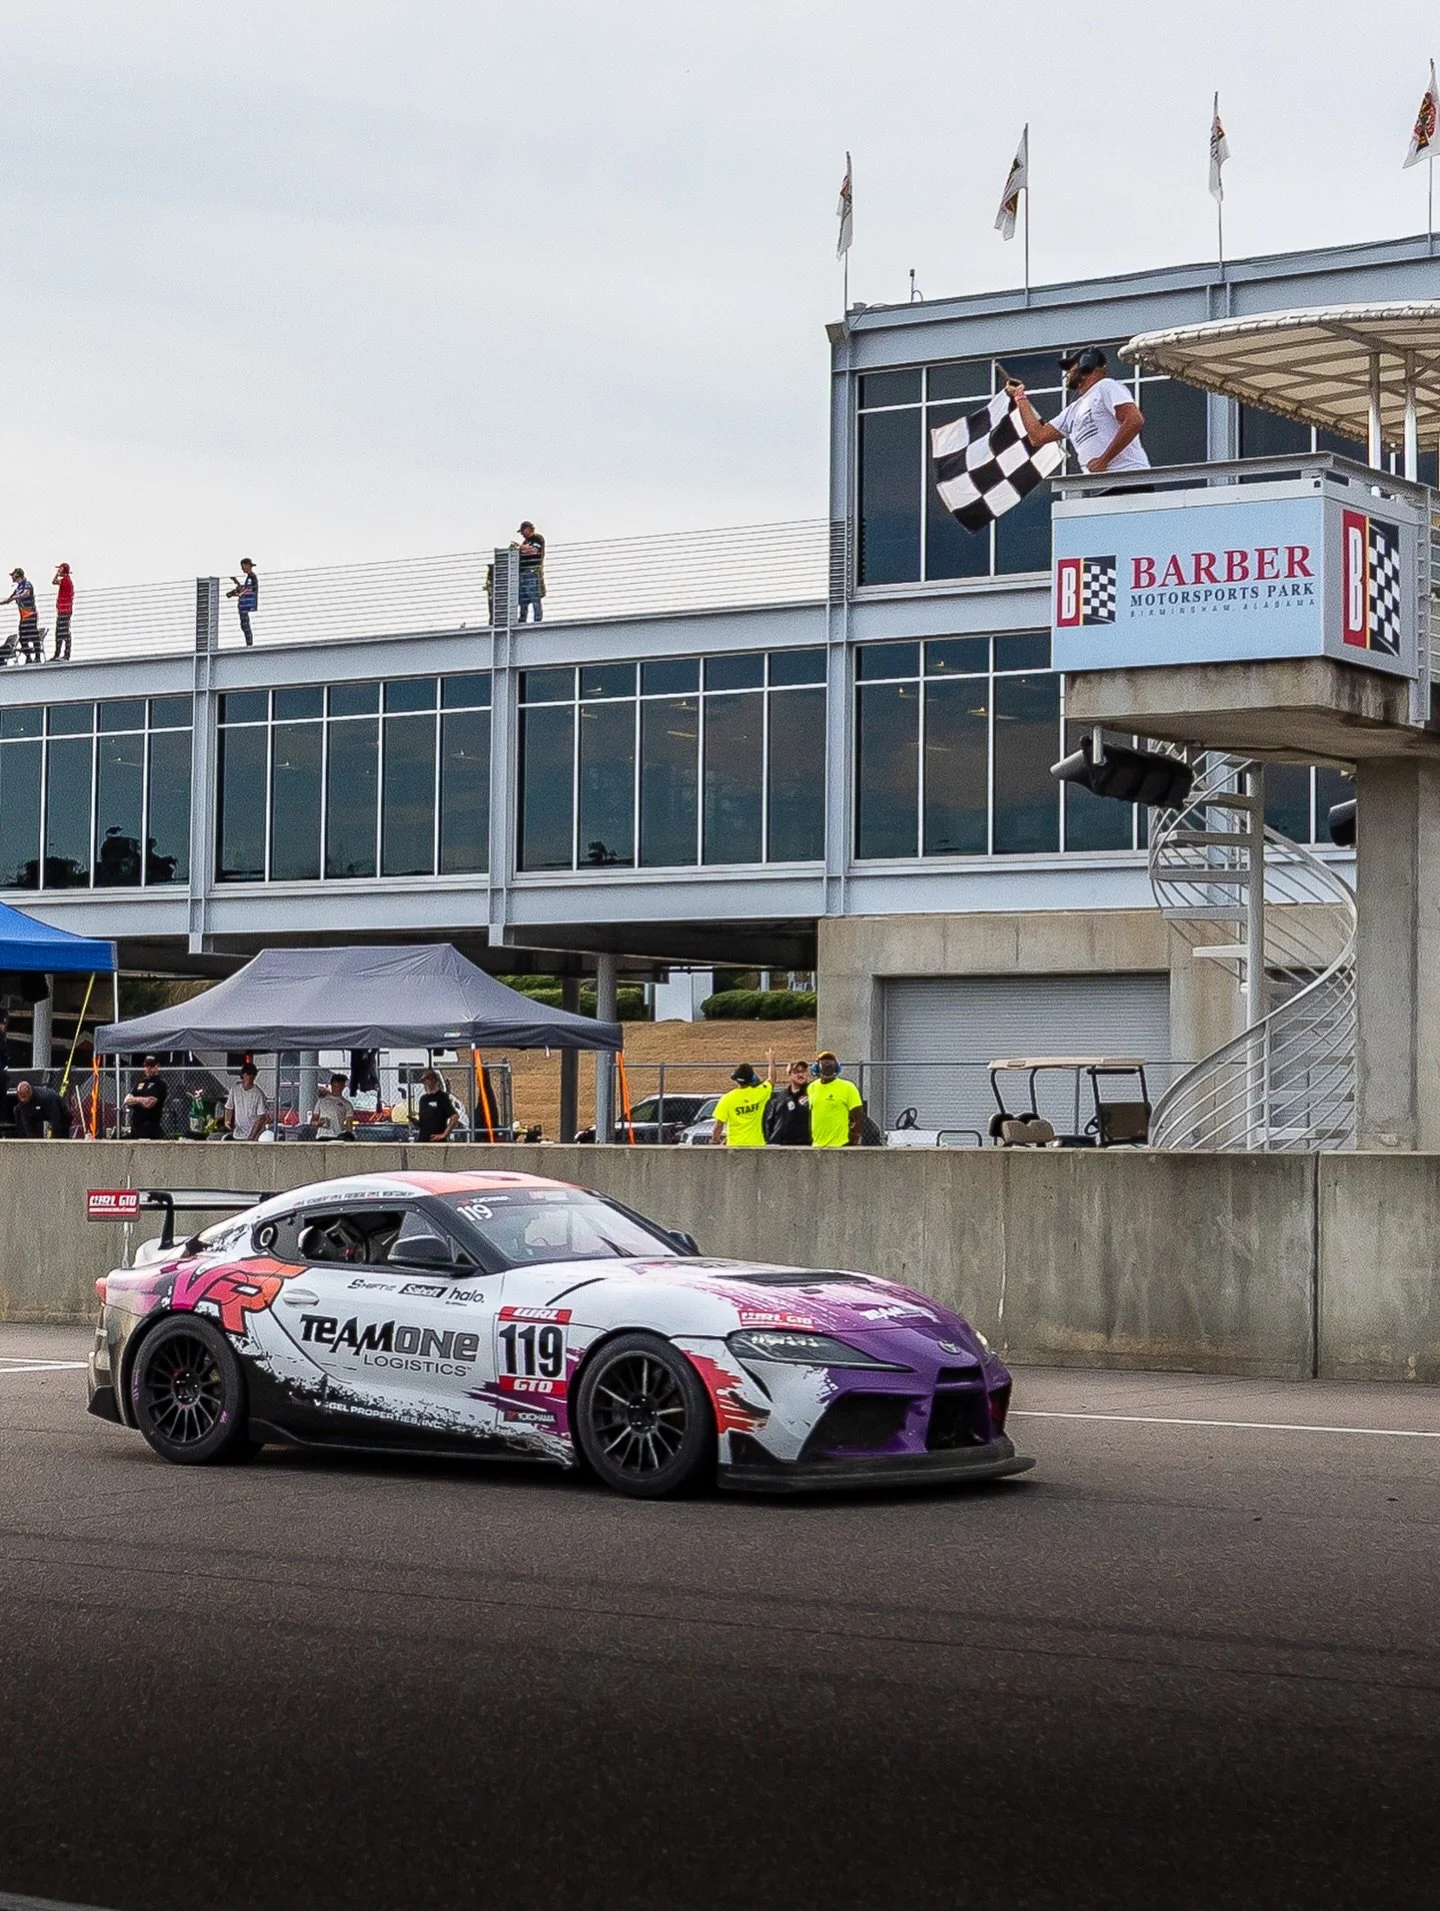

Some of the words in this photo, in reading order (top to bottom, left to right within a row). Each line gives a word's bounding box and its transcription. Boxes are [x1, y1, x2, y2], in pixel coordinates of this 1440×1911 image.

[1130, 545, 1316, 590] BARBER
[1348, 526, 1363, 632] B
[1061, 566, 1077, 620] B
[1130, 585, 1260, 607] MOTORSPORTS
[1267, 582, 1315, 598] PARK
[735, 1102, 760, 1116] STAFF
[457, 1203, 494, 1222] 119
[513, 1307, 559, 1321] WRL
[499, 1324, 563, 1378] 119
[513, 1378, 554, 1394] GTO
